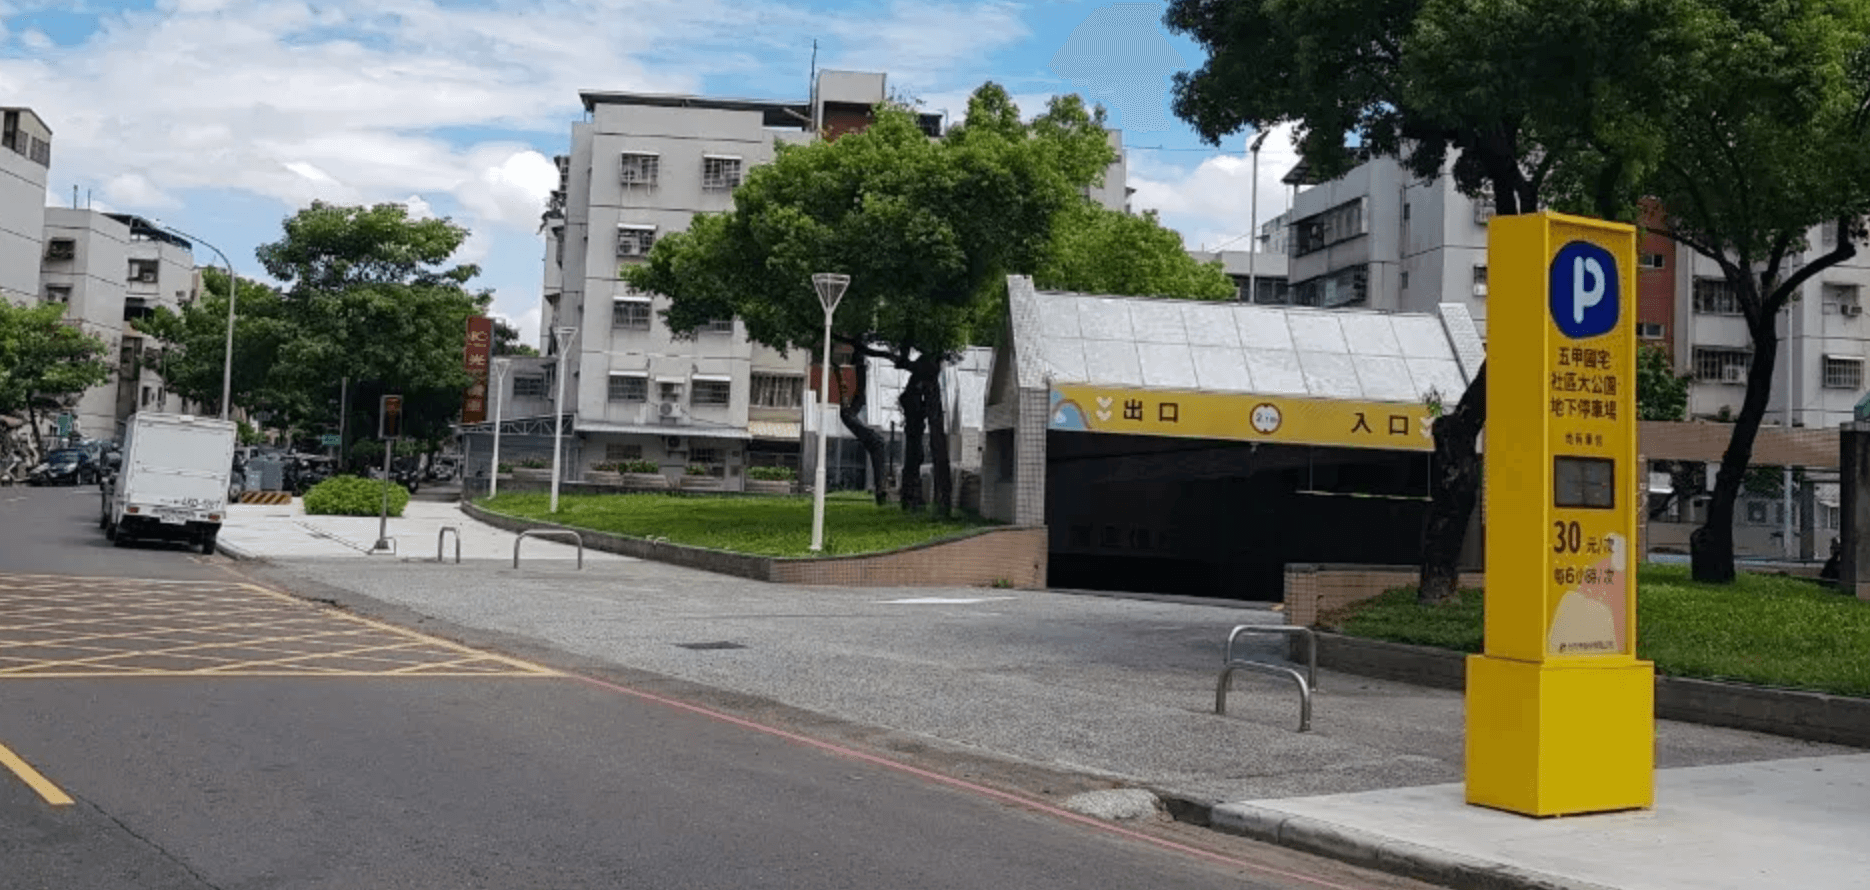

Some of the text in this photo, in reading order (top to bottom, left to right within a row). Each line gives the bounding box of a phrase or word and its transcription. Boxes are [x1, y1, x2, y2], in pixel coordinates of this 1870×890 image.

[1573, 256, 1605, 324] P
[1558, 346, 1611, 369] 五甲國宅
[1551, 371, 1616, 395] 社區大公園
[1124, 399, 1179, 424] 出口
[1550, 394, 1616, 421] 地下停車場
[1350, 412, 1409, 436] 入口
[1553, 520, 1615, 555] 30 元/次
